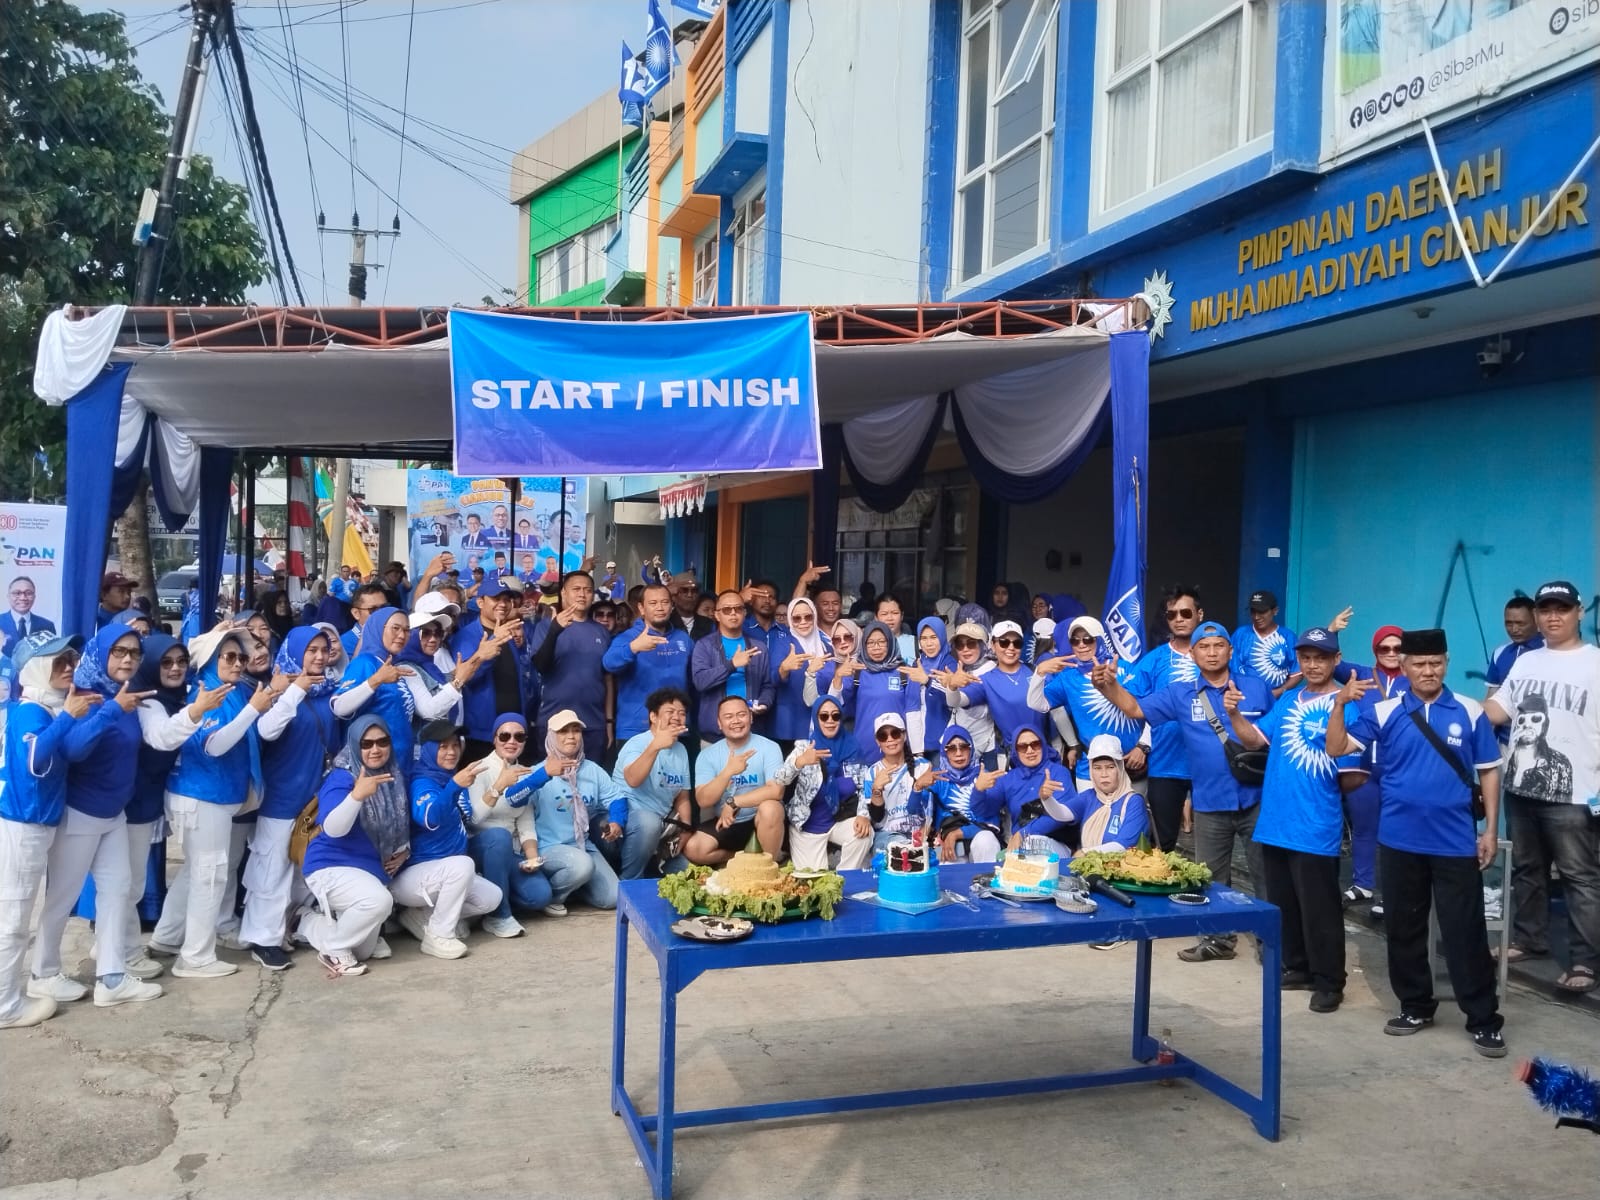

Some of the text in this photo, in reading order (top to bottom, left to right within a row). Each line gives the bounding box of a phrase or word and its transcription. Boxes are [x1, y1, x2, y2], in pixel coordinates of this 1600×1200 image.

[1238, 147, 1502, 275] PIMPINAN DAERAH
[1190, 181, 1589, 333] MUHAMMADIYAH CIANJUR
[471, 377, 800, 411] START / FINISH
[16, 546, 55, 559] PAN
[1108, 609, 1142, 657] PAN
[1447, 736, 1463, 747] PAN
